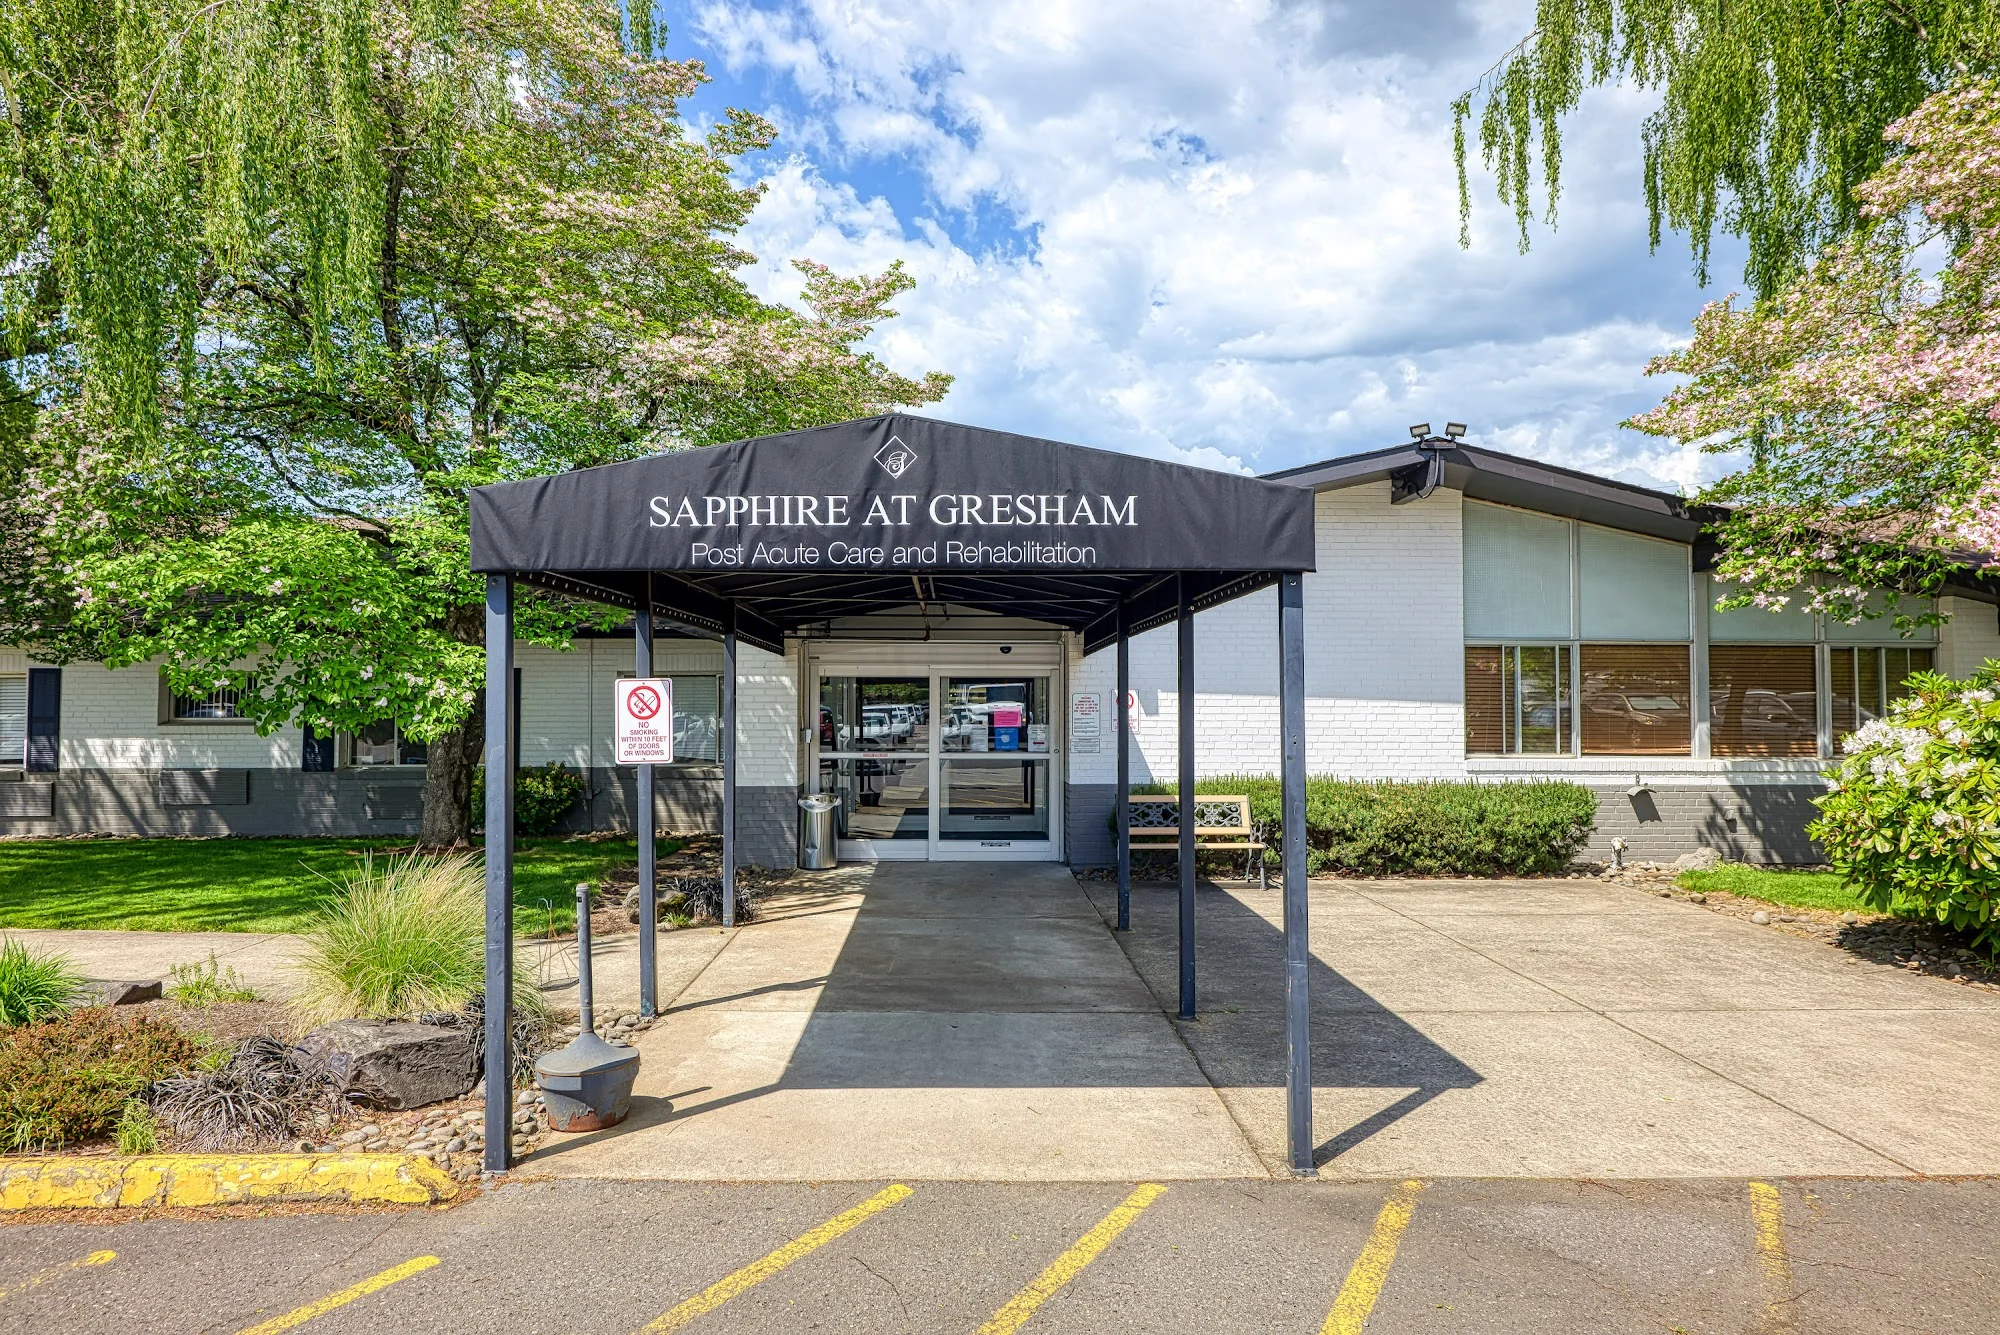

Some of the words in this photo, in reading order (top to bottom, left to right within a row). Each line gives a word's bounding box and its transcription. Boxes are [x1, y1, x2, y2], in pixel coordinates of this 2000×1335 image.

[649, 495, 851, 527] SAPPHIRE
[862, 494, 917, 526] AT
[928, 494, 1139, 526] GRESHAM
[692, 542, 745, 565] Post
[751, 541, 820, 565] Acute
[827, 541, 885, 565] Care
[892, 541, 937, 565] and
[946, 540, 1096, 565] Rehabilitation
[638, 721, 650, 729] NO
